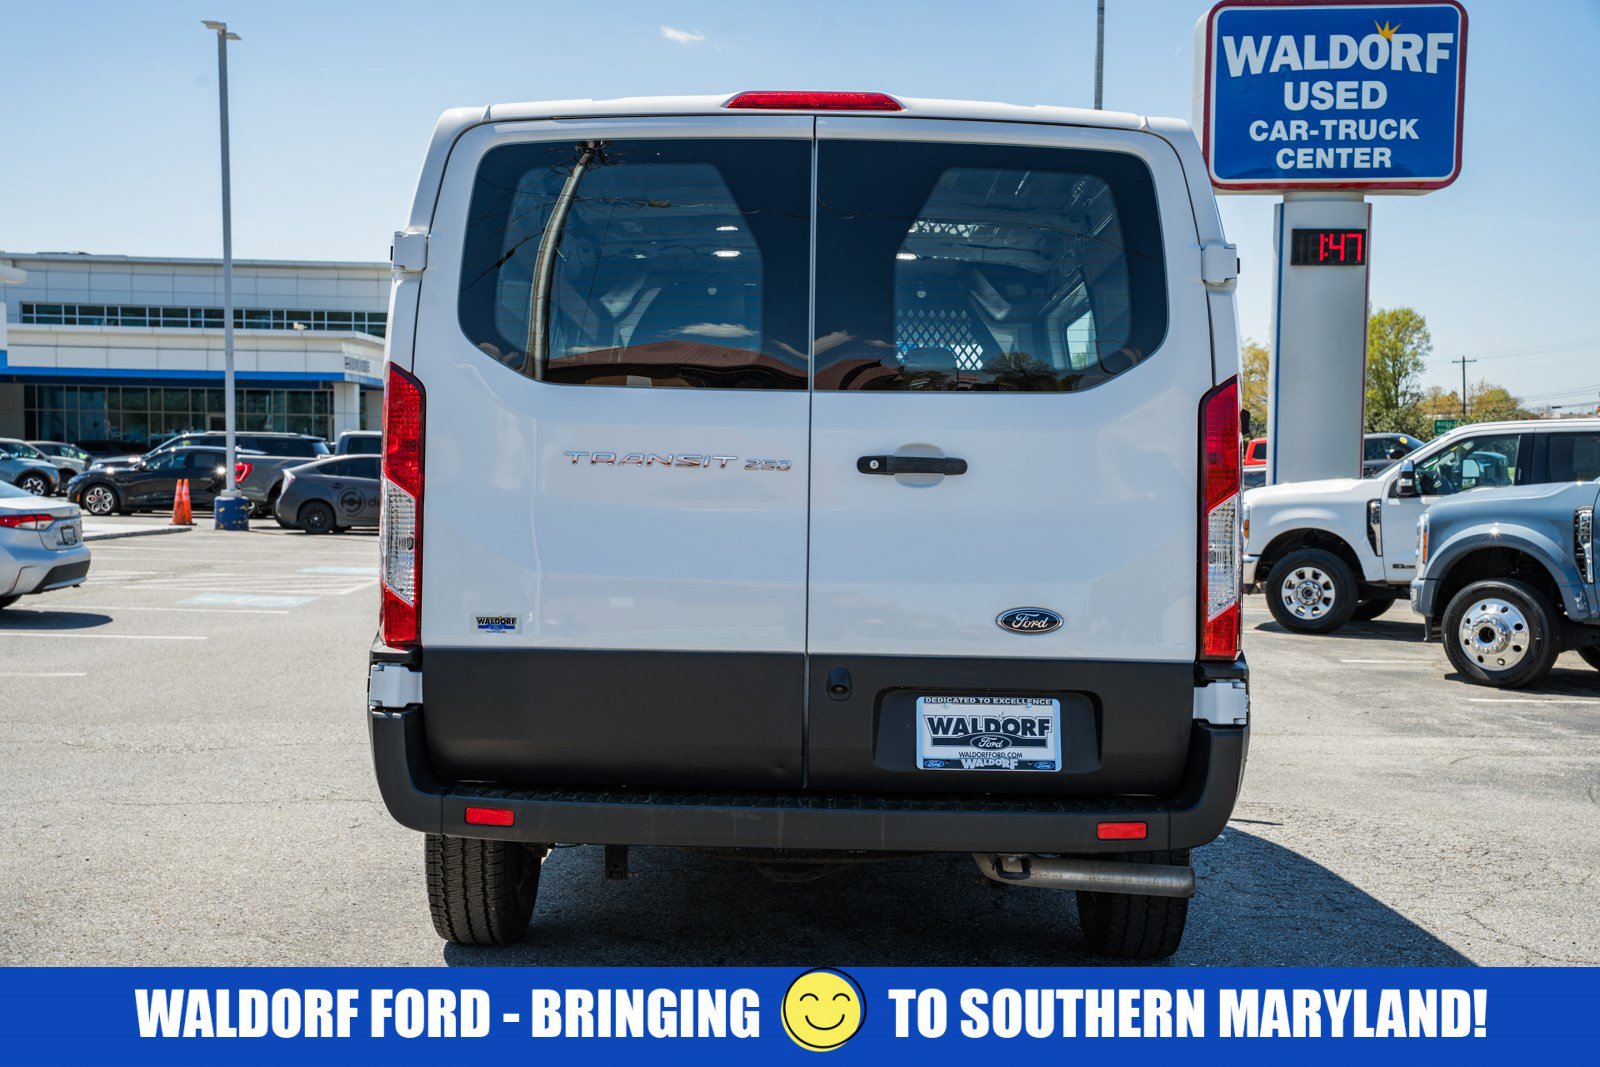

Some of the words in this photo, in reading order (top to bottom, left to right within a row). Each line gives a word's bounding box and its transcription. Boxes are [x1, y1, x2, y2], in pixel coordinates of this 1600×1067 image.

[1222, 33, 1454, 78] WALDORF
[1283, 80, 1388, 111] USED
[1249, 118, 1420, 142] CAR-TRUCK
[1275, 147, 1392, 170] CENTER
[1319, 233, 1363, 262] 1:47
[563, 450, 738, 469] TRANSIT
[744, 458, 792, 471] 250
[475, 616, 517, 625] WALDORF
[1012, 612, 1049, 628] Ford
[925, 715, 1051, 737] WALDORF
[977, 737, 1004, 748] Ford
[958, 751, 1023, 759] WALDORFFORD.COM
[960, 758, 1019, 769] WALDORF
